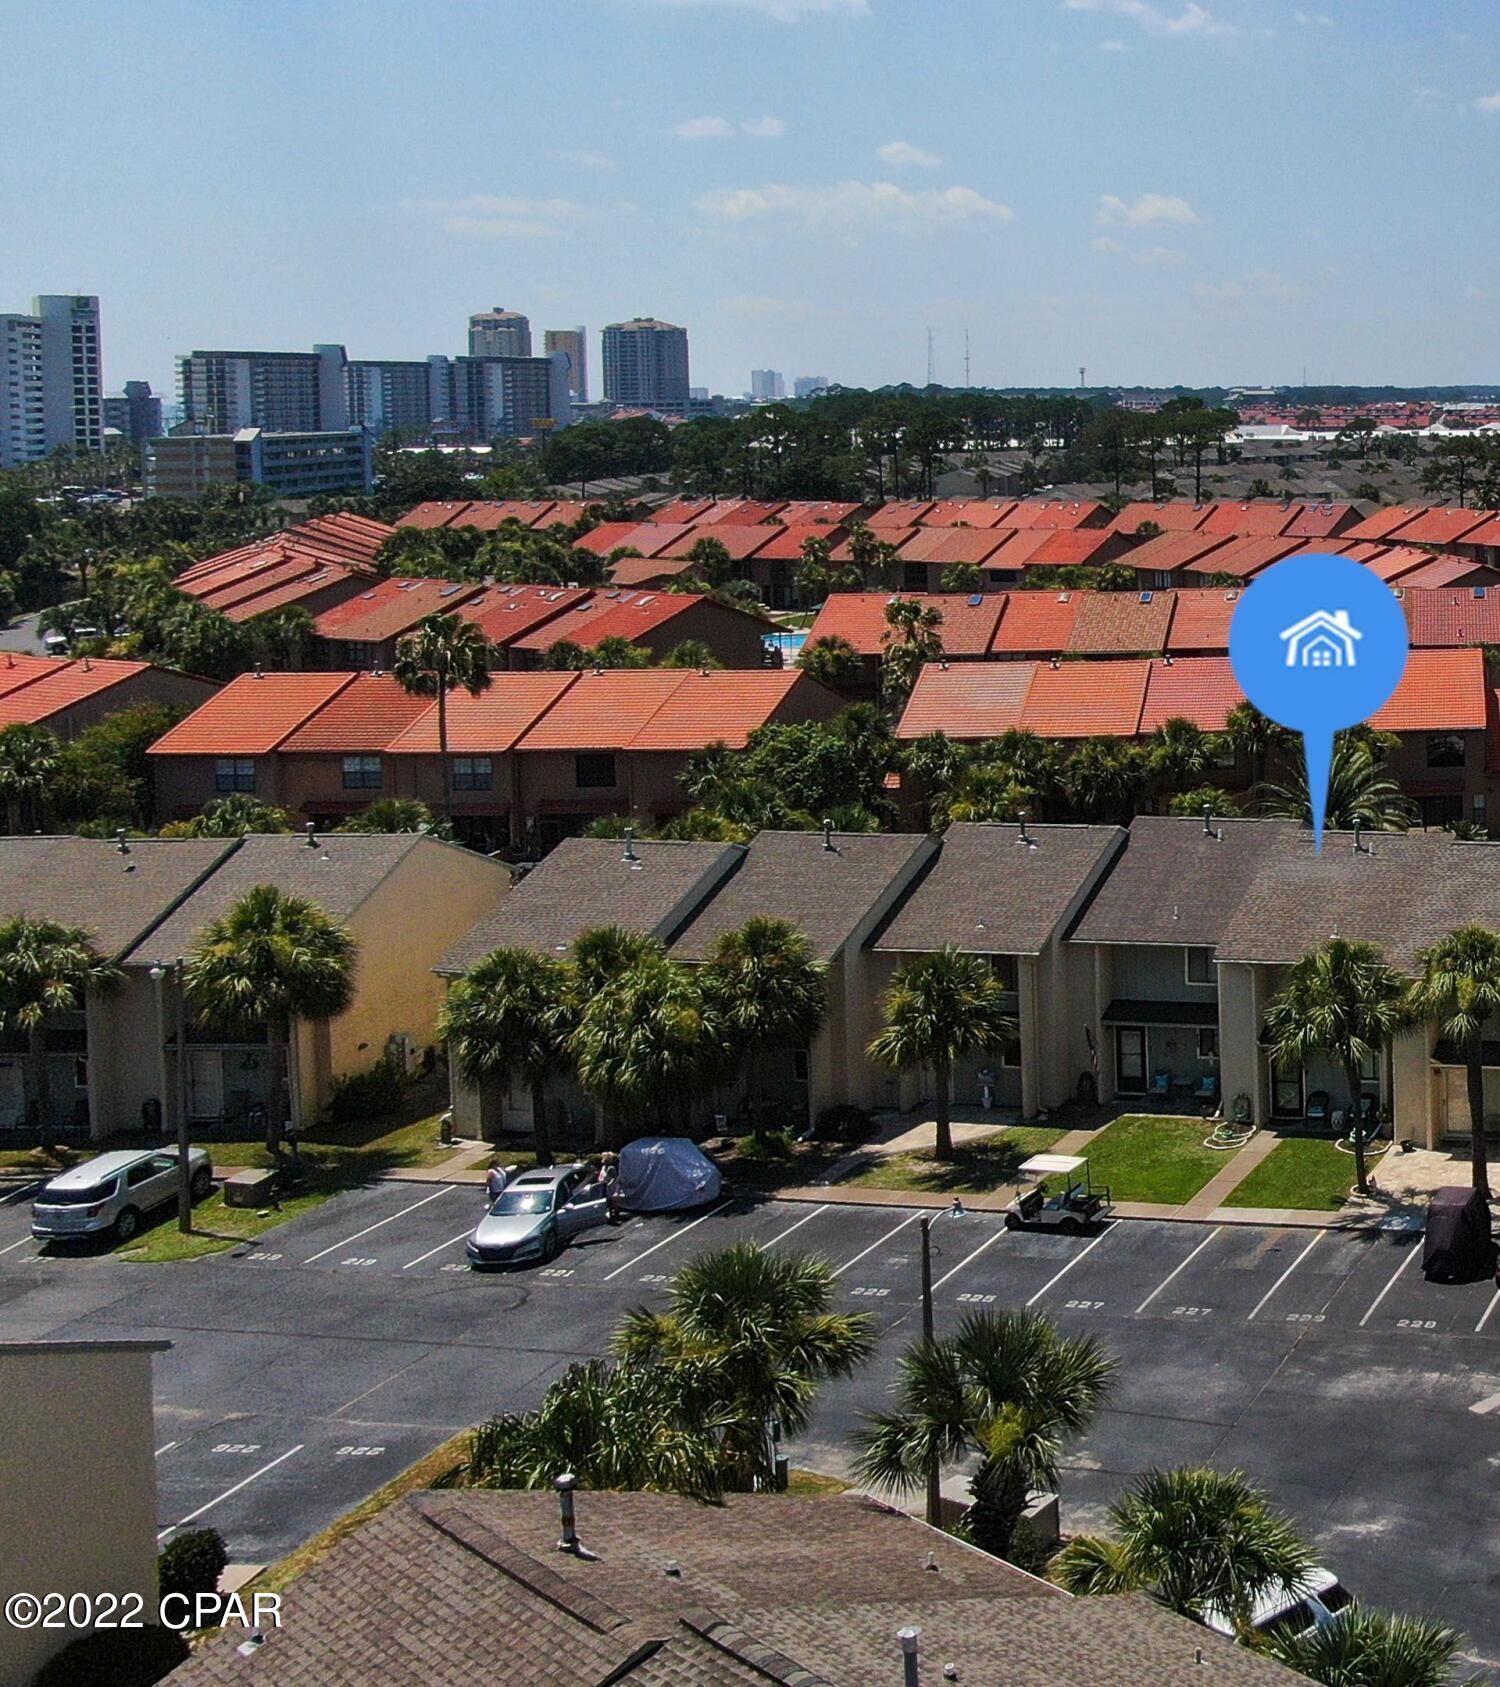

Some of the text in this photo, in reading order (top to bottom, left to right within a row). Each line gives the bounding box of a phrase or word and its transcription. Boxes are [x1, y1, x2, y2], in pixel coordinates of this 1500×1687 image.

[539, 1269, 575, 1278] 221
[851, 1287, 891, 1296] 225
[956, 1293, 997, 1303] 225
[1065, 1300, 1105, 1310] 227
[1172, 1306, 1213, 1316] 227
